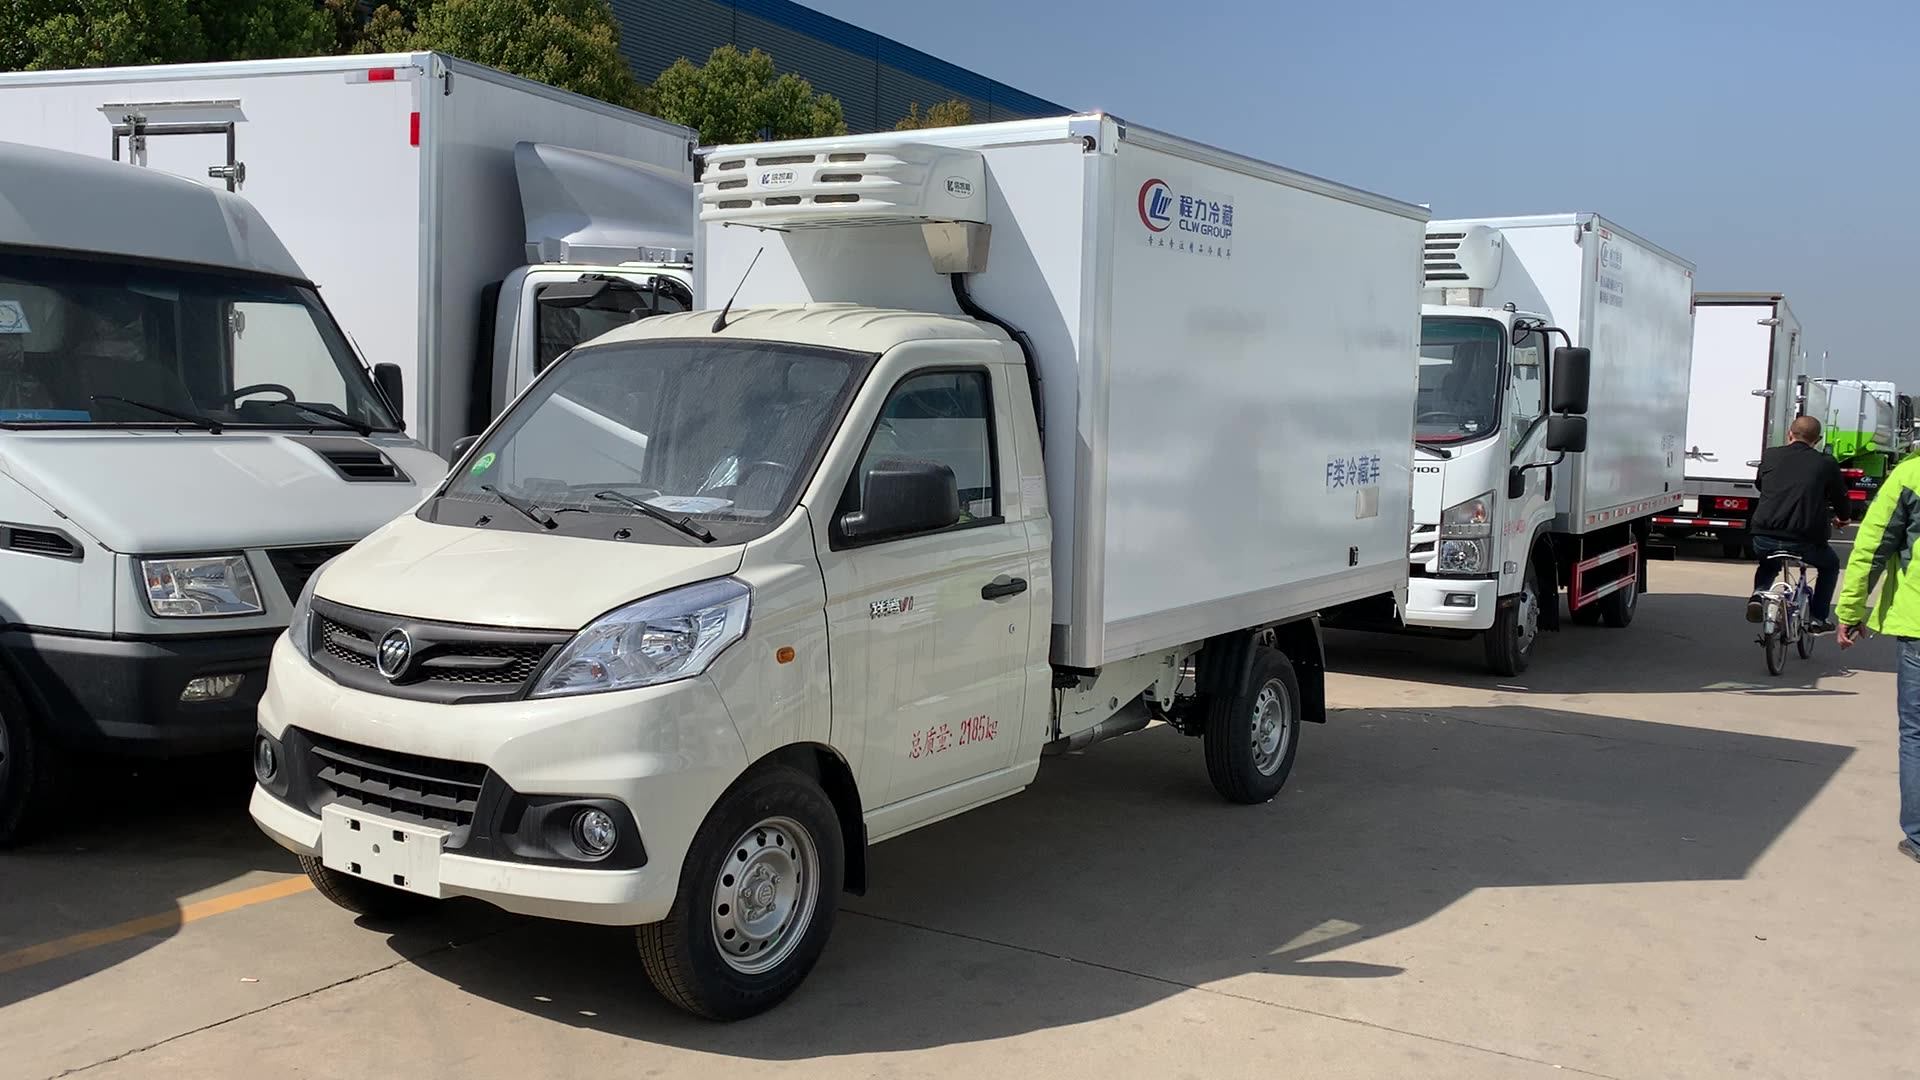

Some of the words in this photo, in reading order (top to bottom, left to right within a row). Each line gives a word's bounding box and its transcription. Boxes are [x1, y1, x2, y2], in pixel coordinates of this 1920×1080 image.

[1179, 194, 1233, 227] 程力冷藏
[1179, 219, 1199, 233] CLW
[1201, 224, 1232, 239] GROUP
[1326, 454, 1380, 488] F类冷藏车
